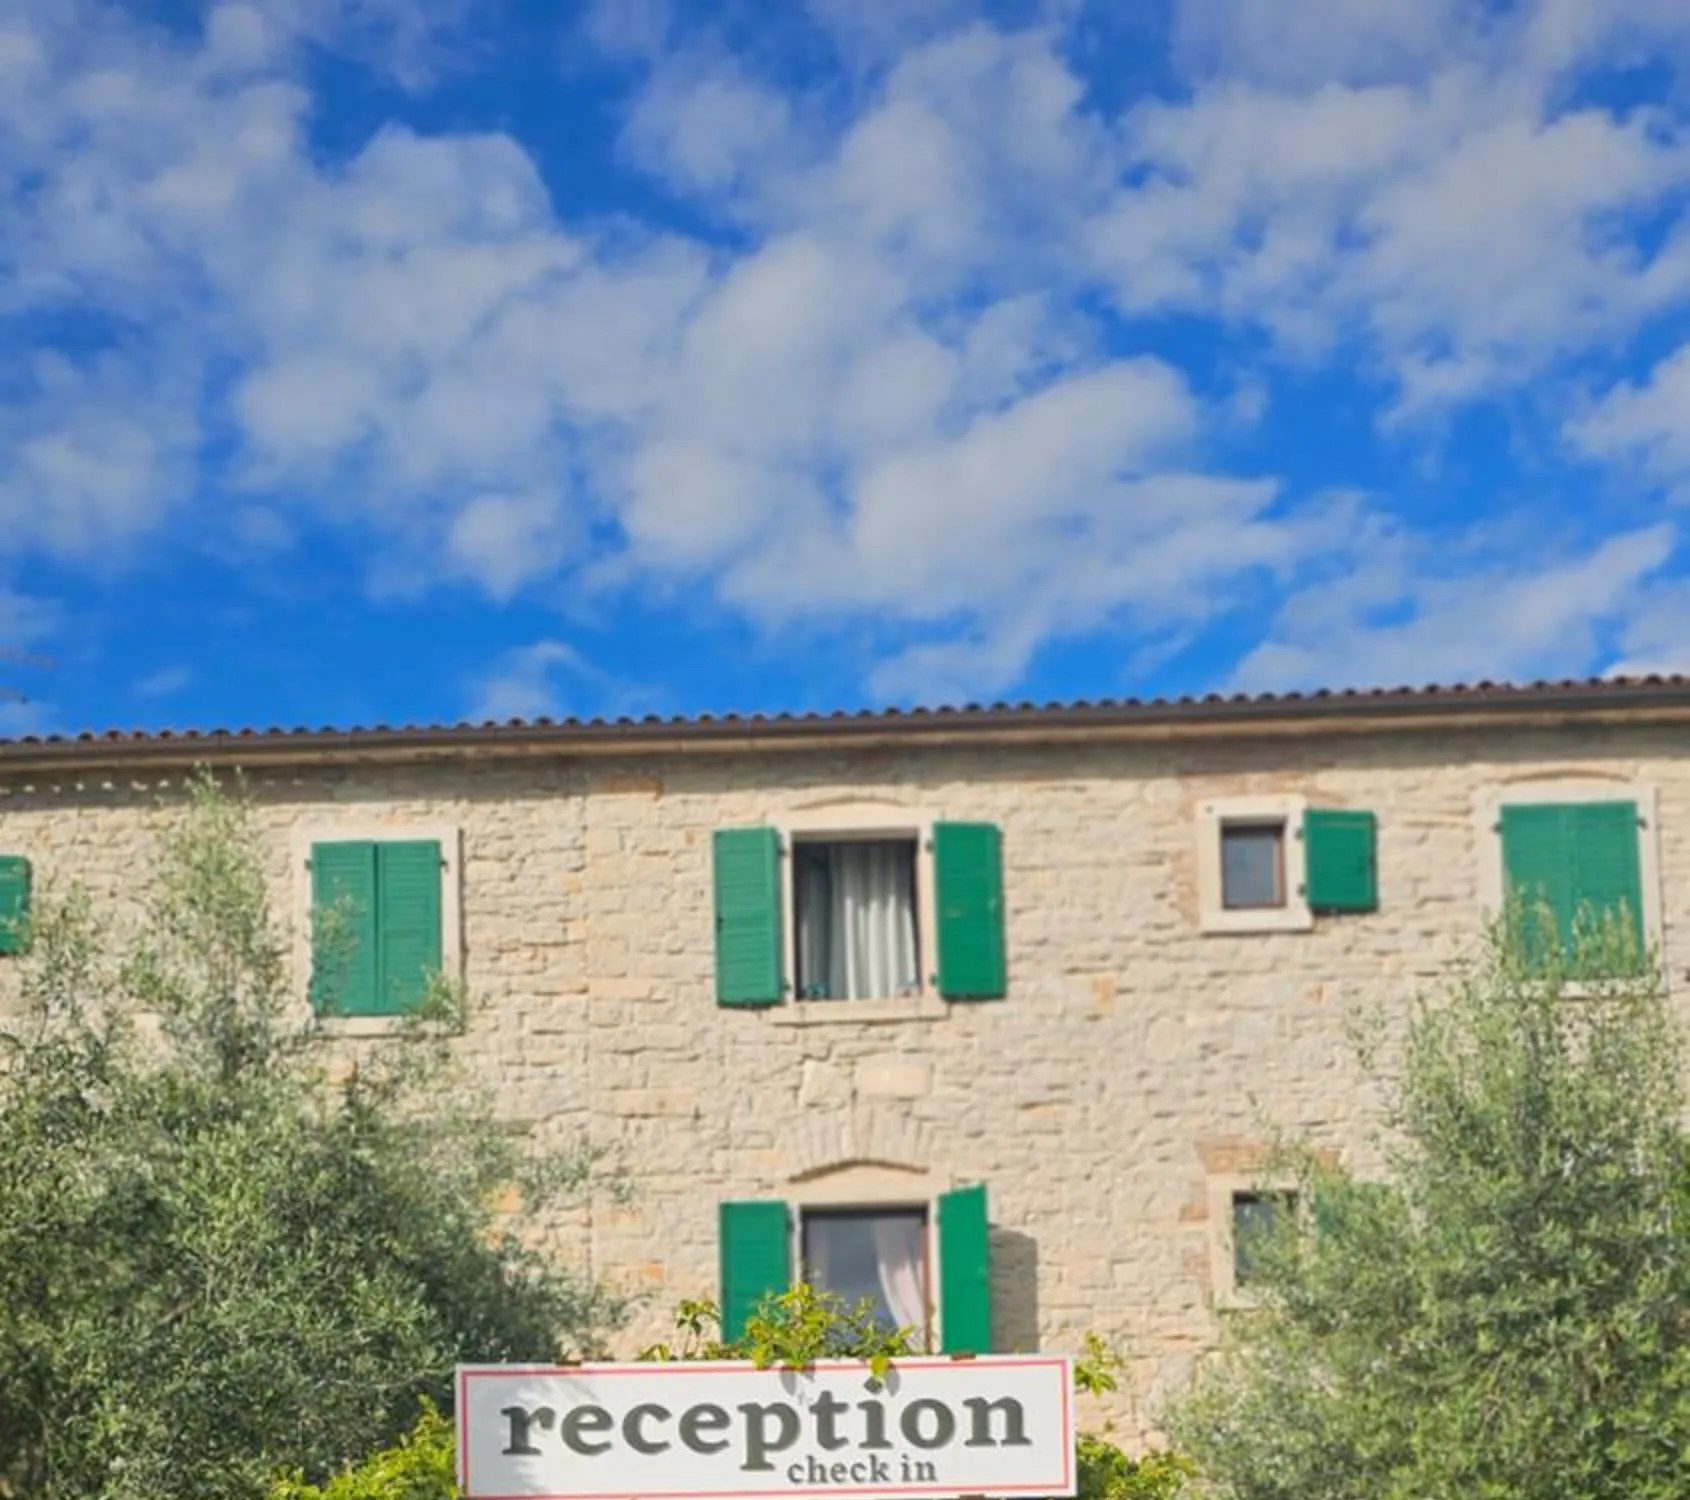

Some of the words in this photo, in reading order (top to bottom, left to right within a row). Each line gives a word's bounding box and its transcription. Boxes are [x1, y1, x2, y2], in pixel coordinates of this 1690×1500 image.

[500, 1376, 1031, 1471] reception
[787, 1453, 889, 1484] check
[901, 1453, 937, 1482] in
